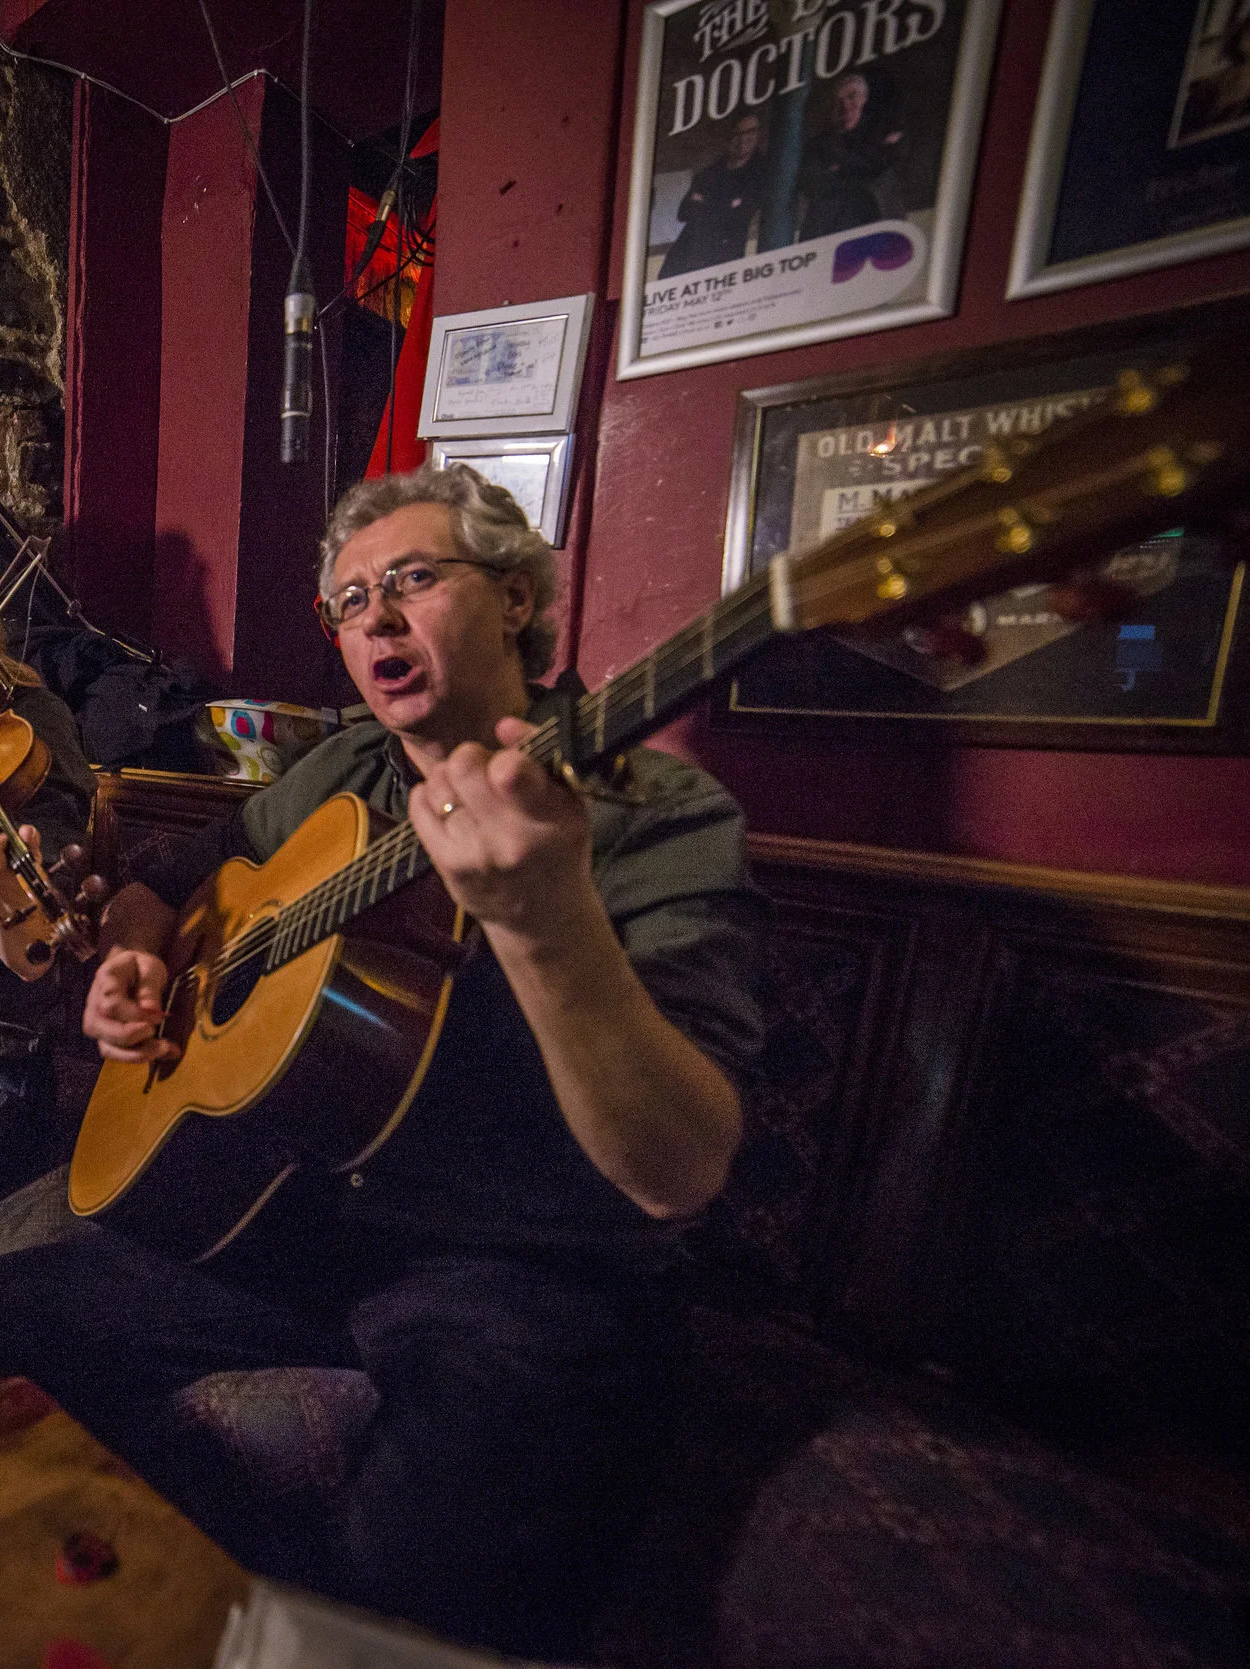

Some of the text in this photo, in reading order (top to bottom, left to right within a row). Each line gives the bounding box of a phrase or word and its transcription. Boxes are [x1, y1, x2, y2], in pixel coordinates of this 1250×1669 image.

[668, 0, 948, 137] DOCTORS
[681, 281, 702, 299] AT
[704, 271, 739, 293] THE
[742, 262, 774, 284] BIG
[779, 251, 818, 274] TOP
[817, 428, 877, 458] OLD
[895, 414, 975, 453] MALT
